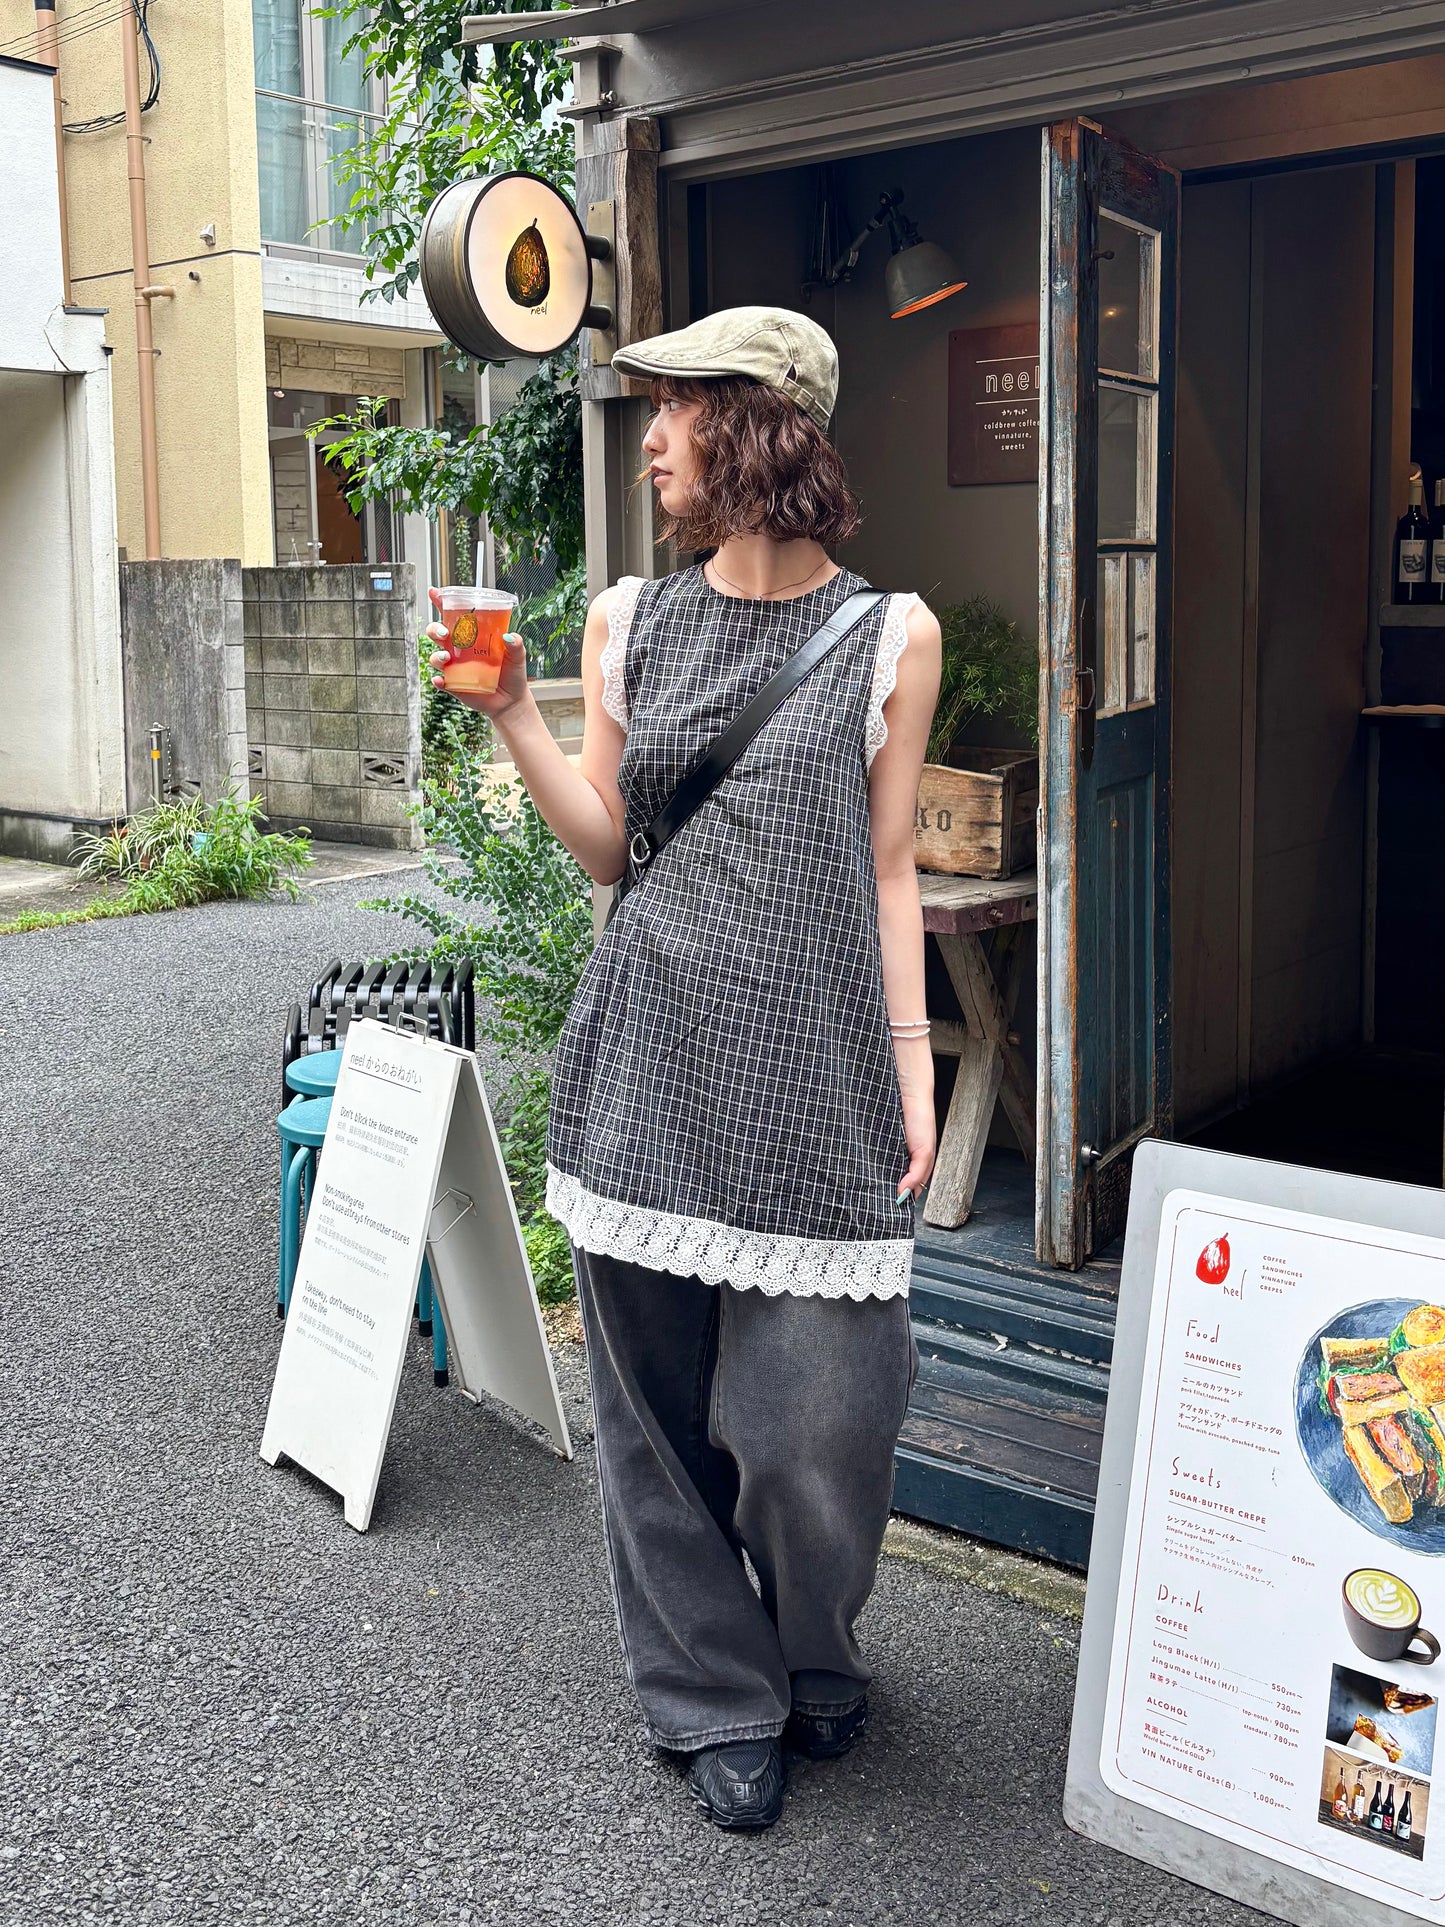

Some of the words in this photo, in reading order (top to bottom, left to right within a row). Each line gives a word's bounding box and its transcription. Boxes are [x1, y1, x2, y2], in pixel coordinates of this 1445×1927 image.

[530, 302, 548, 315] neel
[985, 365, 1040, 393] neel
[984, 421, 1016, 430] coldbrew
[1001, 443, 1025, 451] sweets
[340, 1106, 353, 1120] Don't
[354, 1112, 368, 1126] block
[368, 1117, 378, 1130] the
[378, 1121, 394, 1136] house
[394, 1129, 419, 1145] entrance
[322, 1195, 335, 1210] Don't
[364, 1215, 377, 1229] from
[377, 1222, 391, 1236] other
[391, 1230, 411, 1246] stores
[1262, 1255, 1287, 1265] COFFEE
[1262, 1265, 1303, 1278] SANDWICHES
[1223, 1269, 1247, 1300] neel
[1259, 1284, 1283, 1294] CREPES
[1261, 1275, 1296, 1287] VINNATURE
[329, 1295, 343, 1310] don't
[343, 1303, 356, 1317] need
[356, 1308, 363, 1321] to
[363, 1313, 376, 1330] stay
[1186, 1319, 1220, 1343] Food
[1184, 1351, 1242, 1371] SANDWICHES
[1172, 1456, 1222, 1489] Sweets
[1238, 1510, 1267, 1525] CREPE
[1157, 1583, 1204, 1614] Drink
[1155, 1615, 1189, 1632] COFFEE
[1152, 1639, 1173, 1654] Long
[1149, 1671, 1178, 1688] 抹茶ラテ
[1146, 1696, 1188, 1718] ALCOHOL
[1141, 1747, 1157, 1759] VIN
[1159, 1753, 1193, 1774] NATURE
[1188, 1751, 1205, 1762] GOLD
